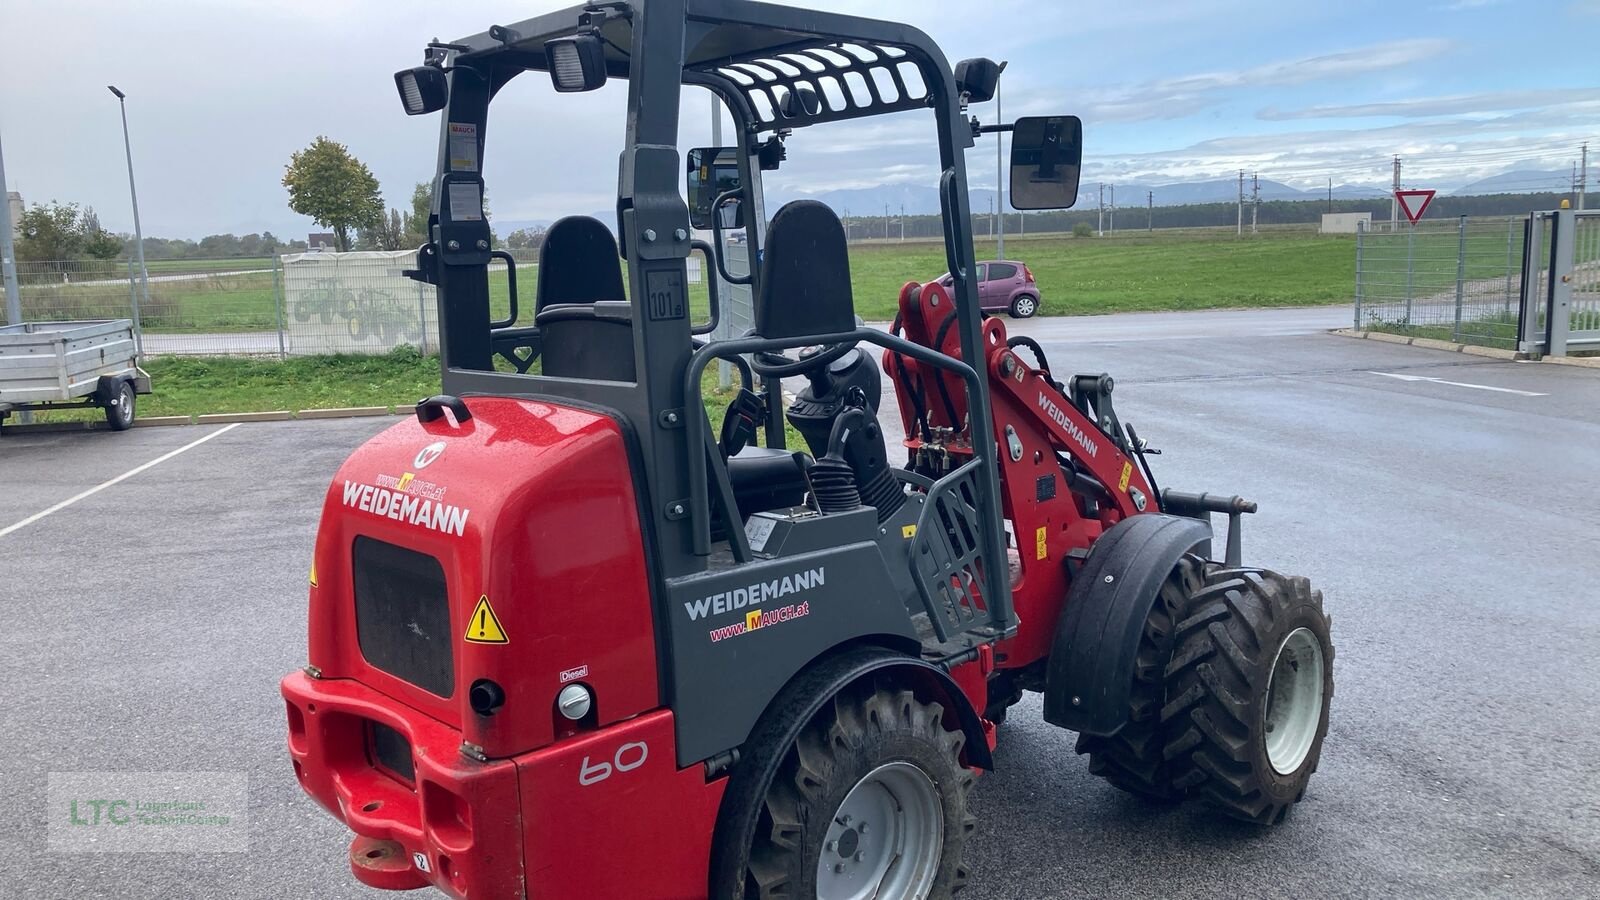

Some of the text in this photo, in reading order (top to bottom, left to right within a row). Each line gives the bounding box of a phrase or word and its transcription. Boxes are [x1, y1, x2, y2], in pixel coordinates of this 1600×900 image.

[452, 126, 475, 134] MAUCH
[651, 291, 673, 317] 101
[1038, 391, 1098, 458] WEIDEMANN
[343, 480, 470, 537] WEIDEMANN
[684, 566, 825, 621] WEIDEMANN
[709, 600, 810, 643] www.MAUCH.at
[561, 667, 587, 681] Diesel
[579, 741, 648, 786] 60
